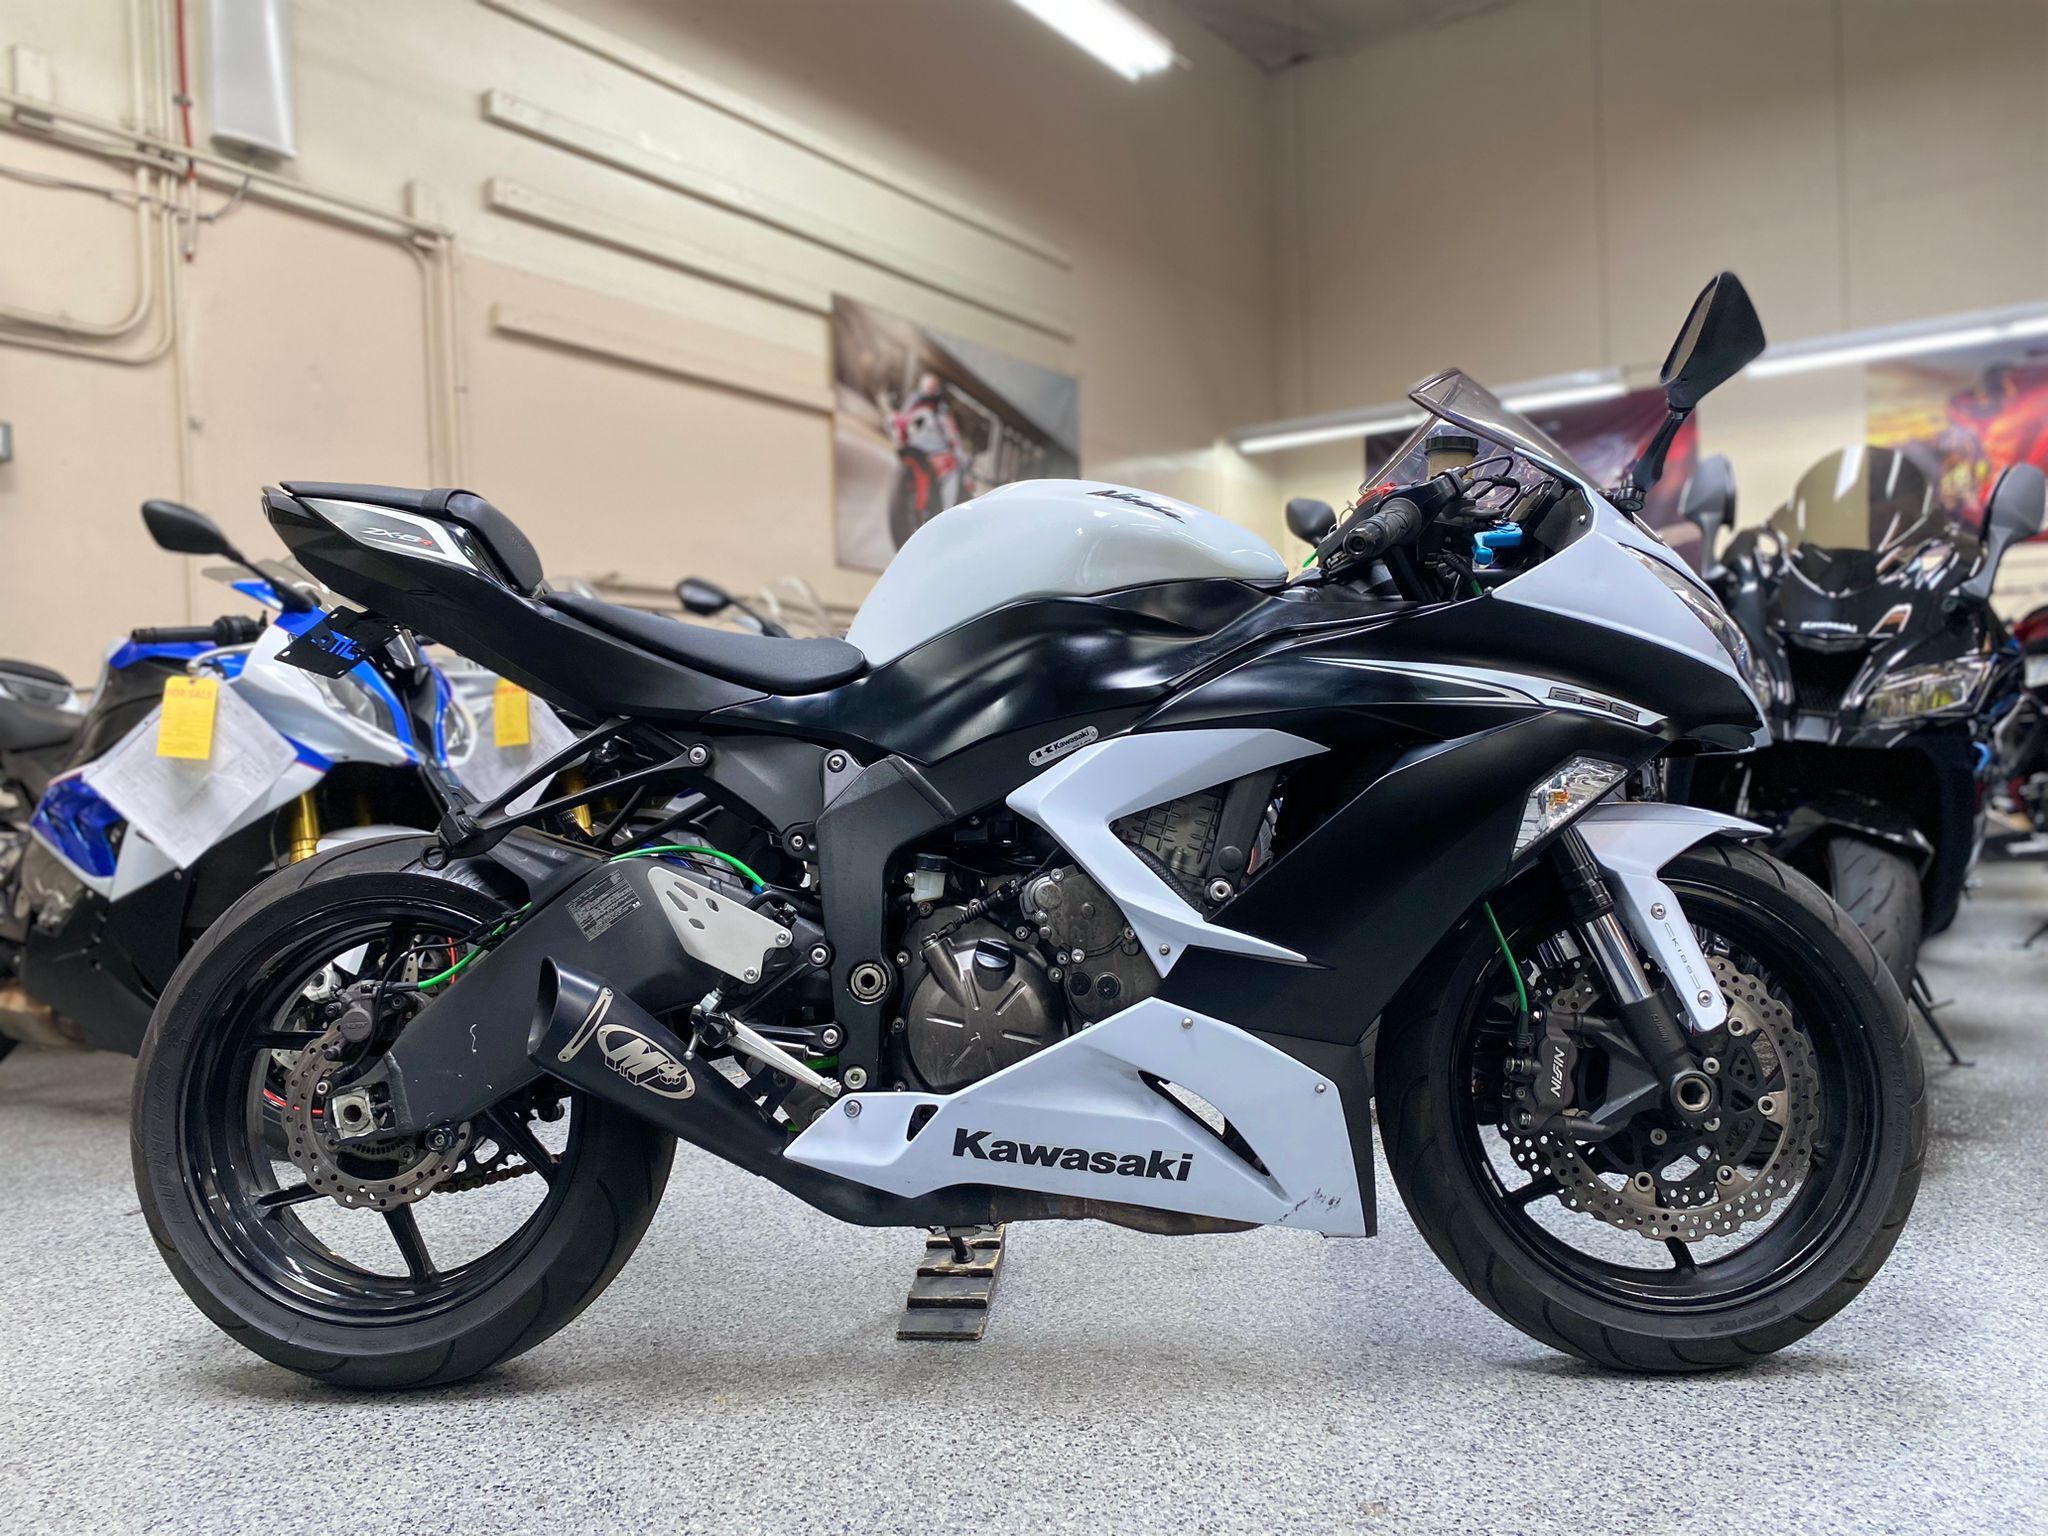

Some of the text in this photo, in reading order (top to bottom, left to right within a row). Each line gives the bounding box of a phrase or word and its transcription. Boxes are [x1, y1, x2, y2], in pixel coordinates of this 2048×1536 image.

[1053, 730, 1090, 750] Kawasaki
[604, 1037, 688, 1086] M4
[952, 1127, 1194, 1182] Kawasaki
